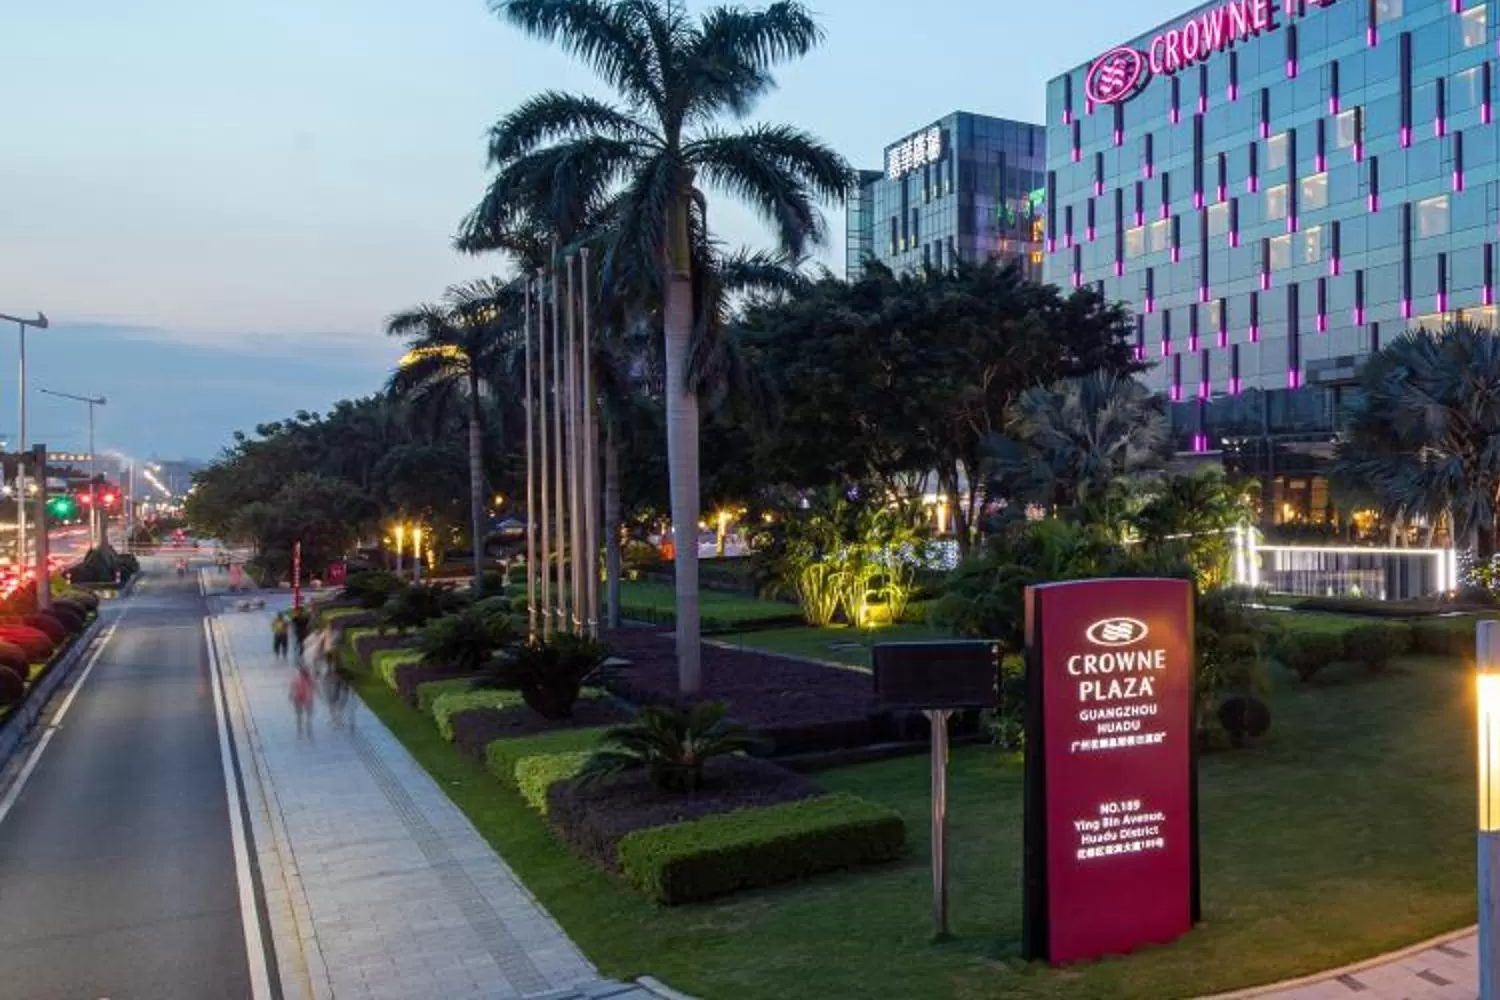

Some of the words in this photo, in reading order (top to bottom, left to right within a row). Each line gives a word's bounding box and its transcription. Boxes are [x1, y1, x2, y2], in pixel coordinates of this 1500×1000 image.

[1067, 649, 1166, 676] CROWNE
[1079, 676, 1154, 702] PLAZA
[1079, 703, 1158, 721] GUANGZHOU
[1097, 719, 1141, 734] HUADU
[1081, 829, 1118, 845] Huadu
[1119, 825, 1159, 839] District
